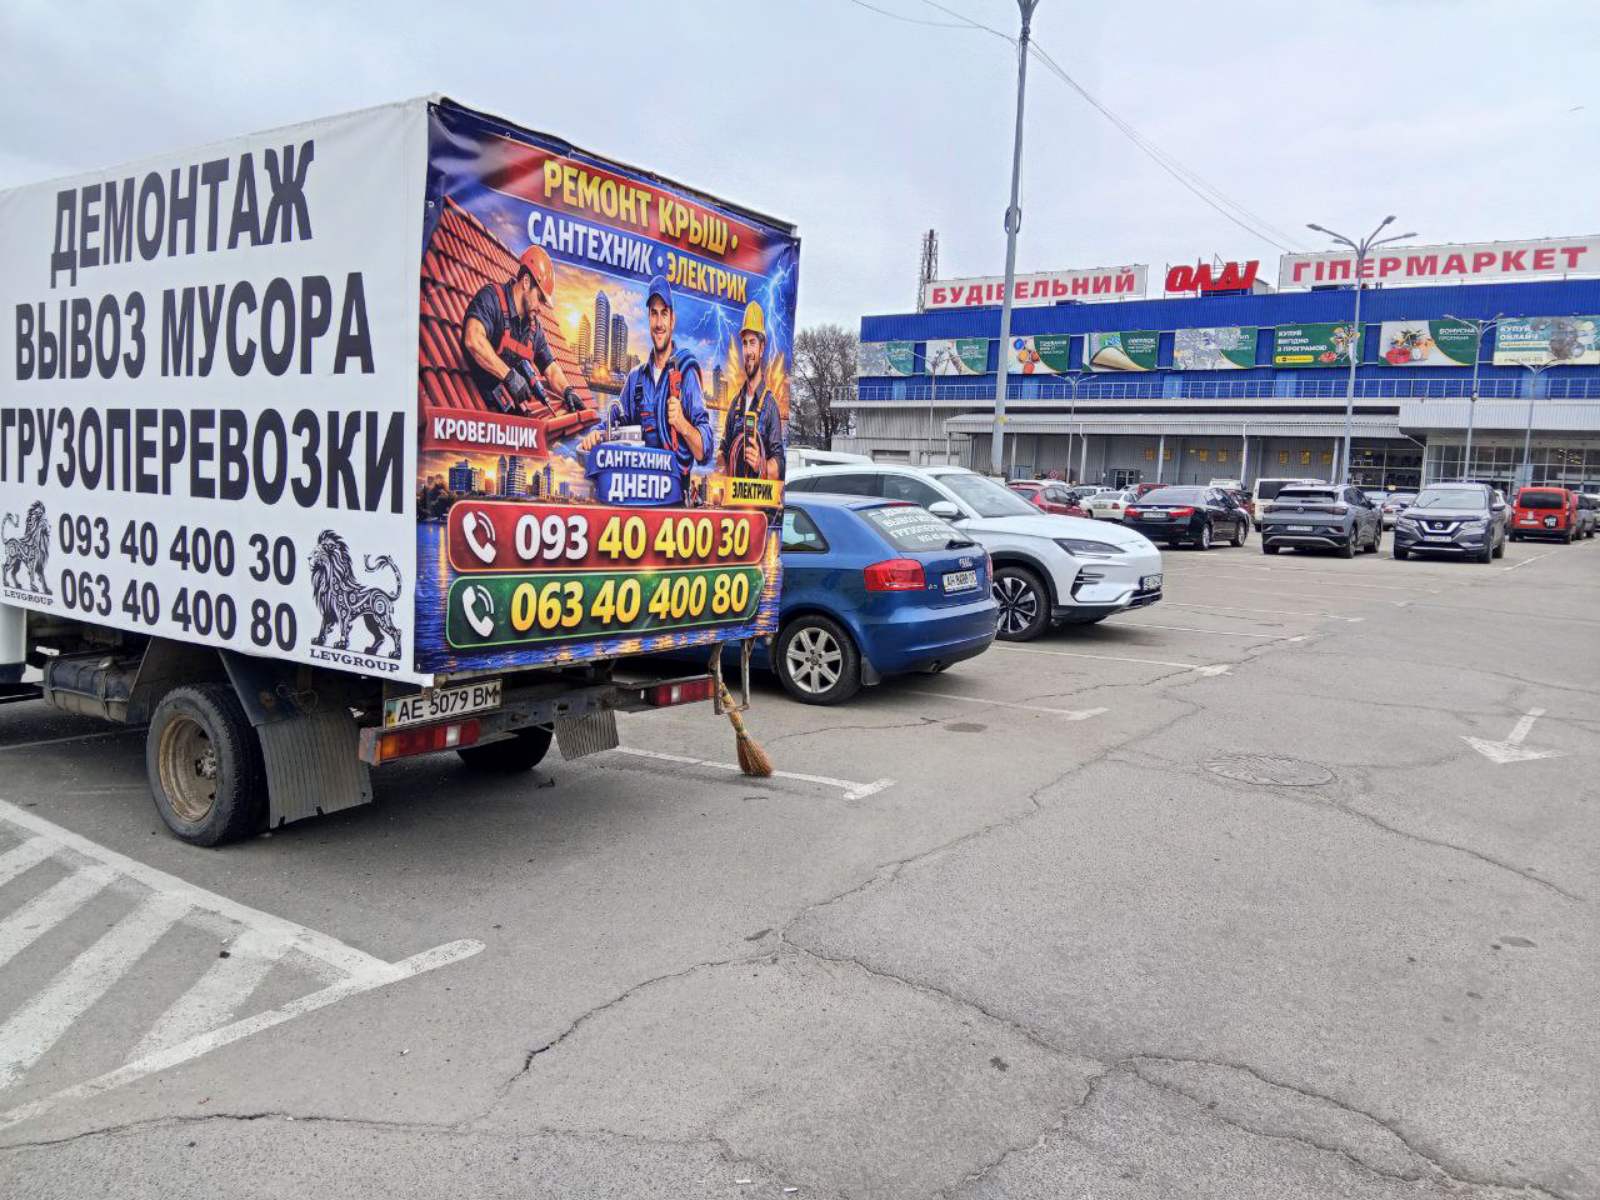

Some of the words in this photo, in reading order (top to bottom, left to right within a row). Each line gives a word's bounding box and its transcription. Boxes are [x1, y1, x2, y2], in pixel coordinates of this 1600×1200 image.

[50, 139, 314, 289] ДЕМОНТАЖ
[543, 160, 653, 227] РЕМОНТ
[658, 200, 729, 256] КРЫШ
[527, 211, 653, 277] САНТЕХНИК
[666, 252, 747, 304] ЭЛЕКТРИК
[1292, 246, 1588, 282] ГІПЕРМАРКЕТ
[15, 290, 146, 381] ВЫВОЗ
[160, 271, 376, 378] МУСОРА
[434, 417, 538, 450] КРОВЕЛЬЩИК
[0, 406, 406, 515] ГРУЗОПЕРЕВОЗКИ
[596, 449, 672, 472] САНТЕХНИК
[608, 473, 672, 502] ДНЕПР
[732, 482, 773, 502] ЭЛЕКТРИК
[59, 513, 110, 560] 093
[120, 519, 158, 567] 40
[169, 525, 235, 577] 400
[248, 533, 296, 586] 30
[515, 514, 588, 561] 093
[598, 516, 646, 559] 40
[654, 517, 713, 559] 400
[717, 518, 750, 556] 30
[4, 590, 54, 606] LEVGROUP
[61, 568, 112, 617] 063
[122, 579, 160, 626] 40
[171, 587, 237, 641] 400
[250, 598, 298, 652] 80
[511, 582, 584, 632] 063
[591, 578, 642, 624] 40
[649, 577, 707, 620] 400
[711, 573, 749, 613] 80
[310, 648, 400, 673] LEVGROUP
[398, 700, 424, 722] AE
[428, 690, 469, 716] 5079
